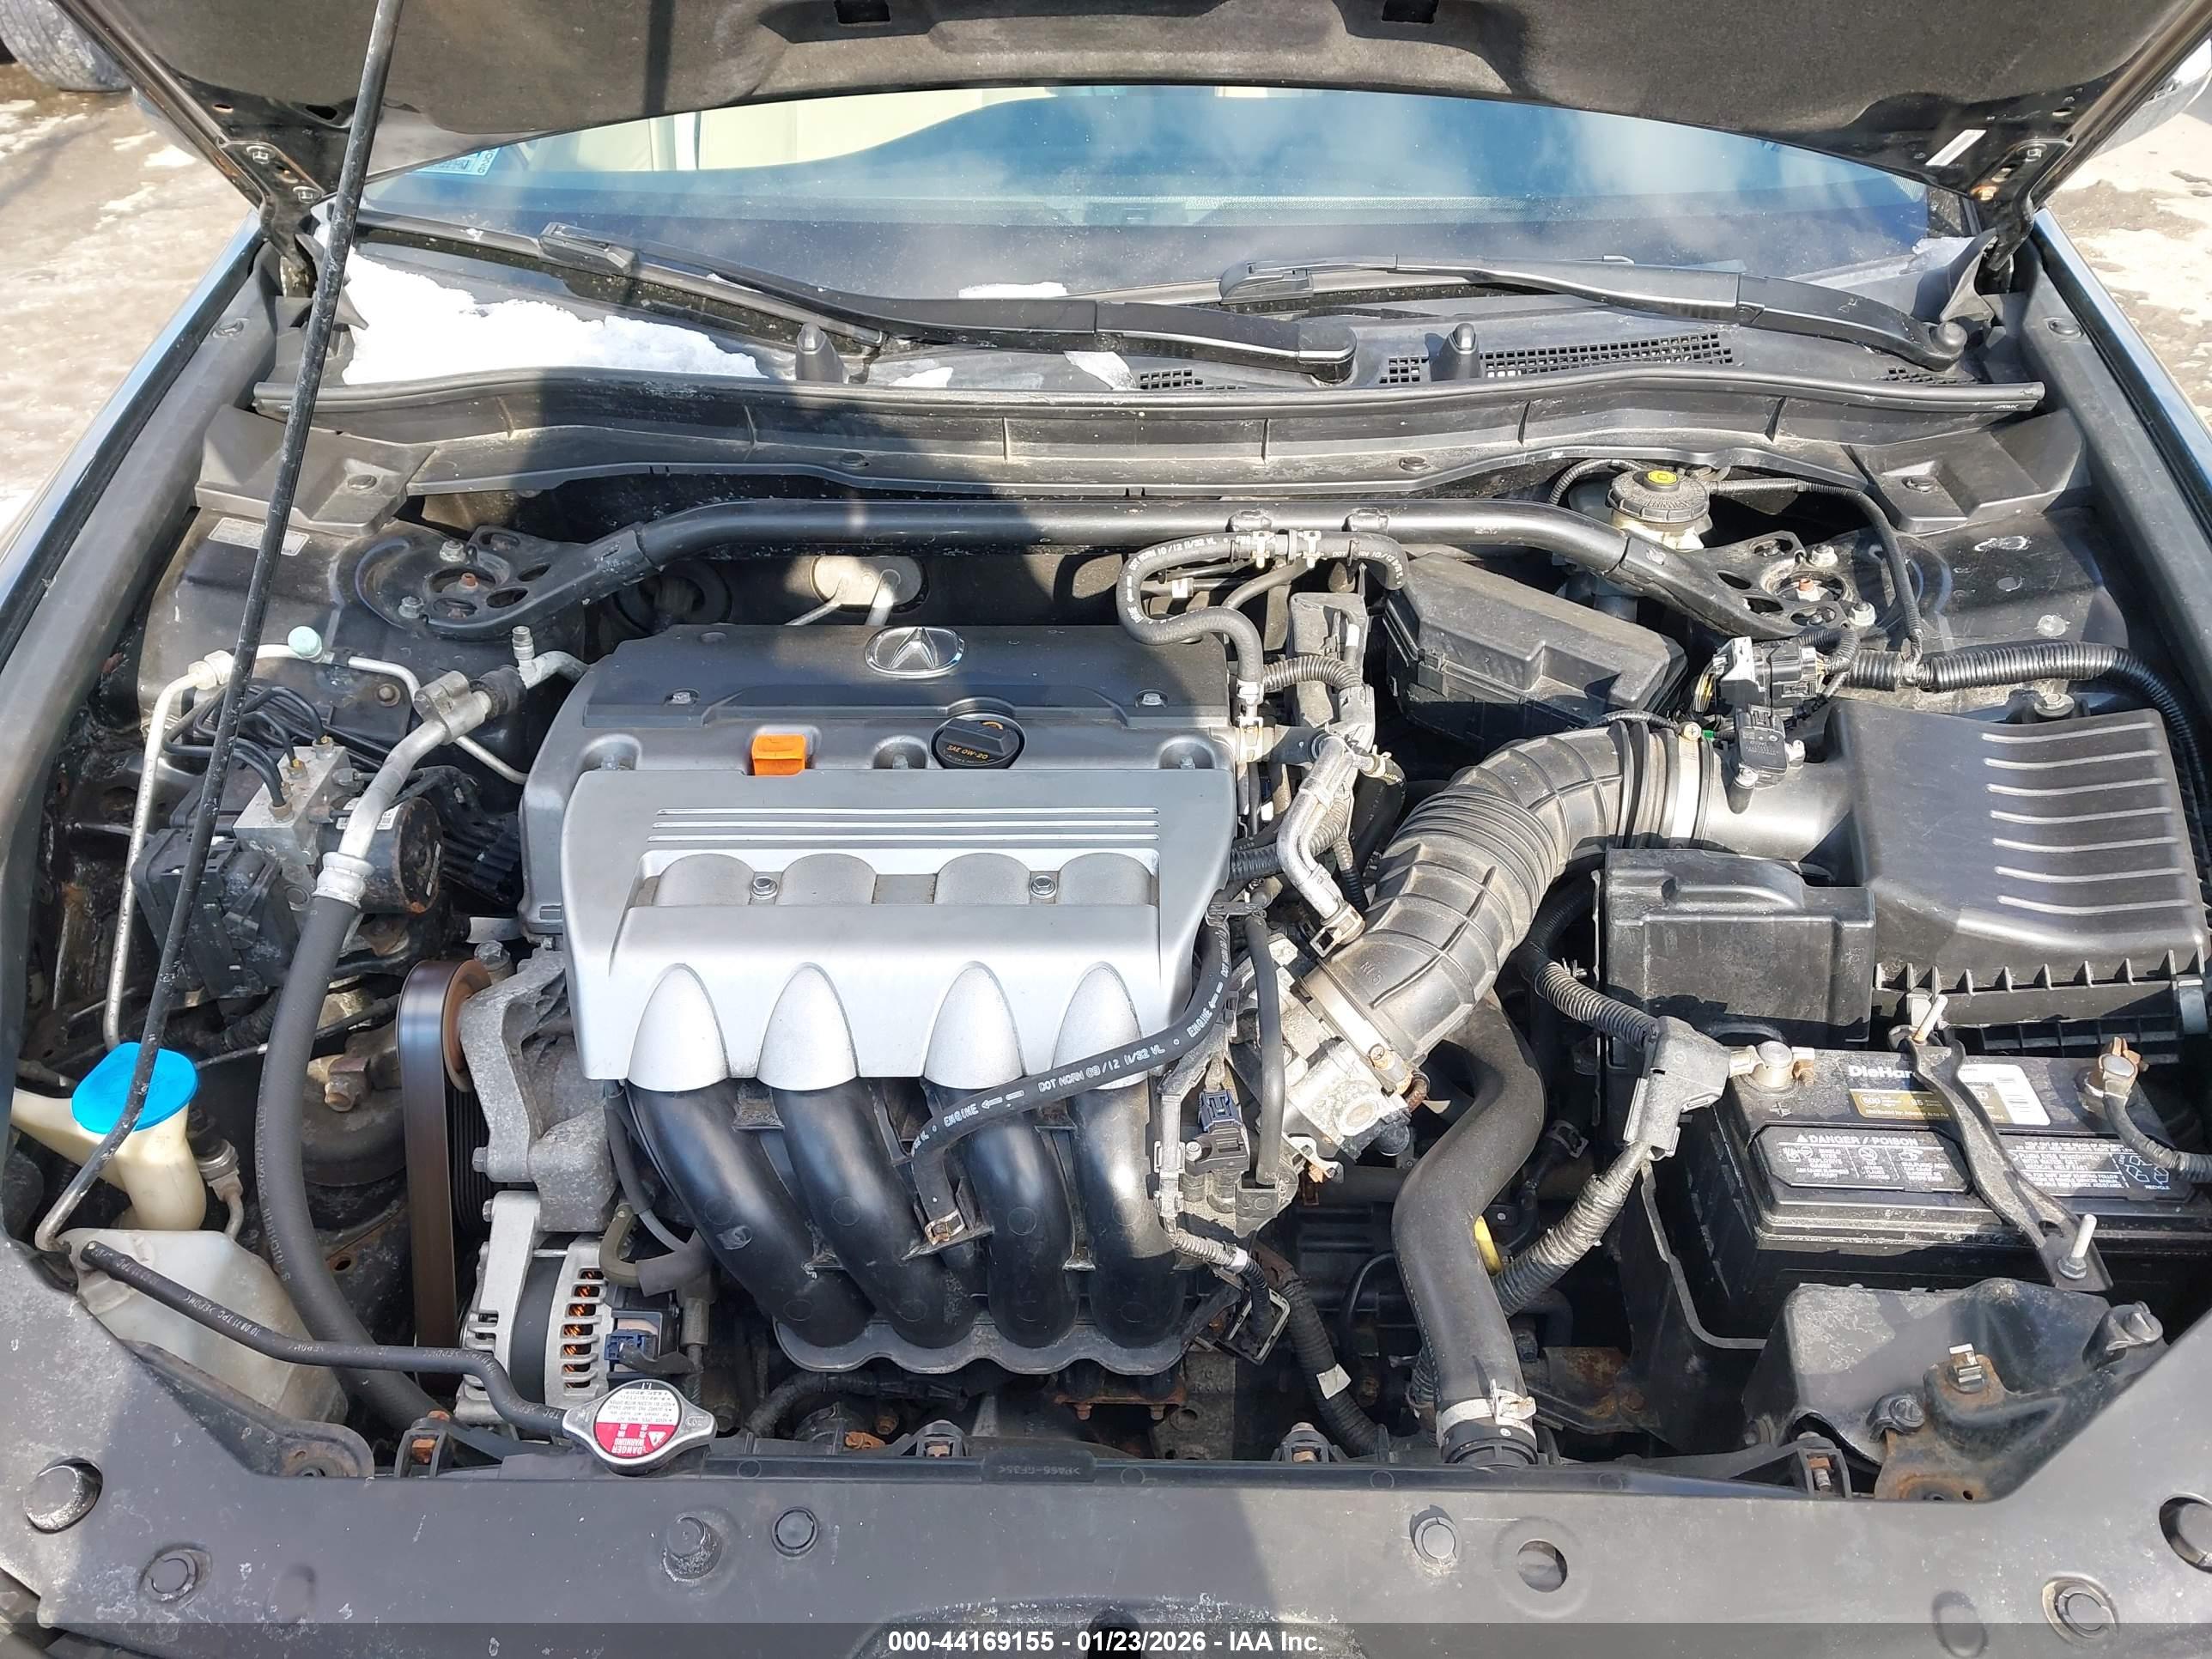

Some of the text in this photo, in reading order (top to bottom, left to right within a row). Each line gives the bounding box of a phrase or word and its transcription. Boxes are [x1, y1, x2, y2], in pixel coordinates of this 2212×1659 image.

[946, 744, 961, 753] SAE
[961, 748, 989, 760] 0W-20
[1187, 1007, 1212, 1037] ENGINE
[1848, 1064, 1913, 1079] DieHar
[944, 1103, 979, 1128] ENGINE
[1038, 1079, 1057, 1093] DOT
[1085, 1059, 1121, 1080] 09/12
[1808, 1134, 1861, 1145] DANGER
[1873, 1136, 1919, 1146] POISON
[641, 1382, 653, 1390] 1.1
[613, 1437, 645, 1446] WARNING
[611, 1445, 645, 1455] DANGER
